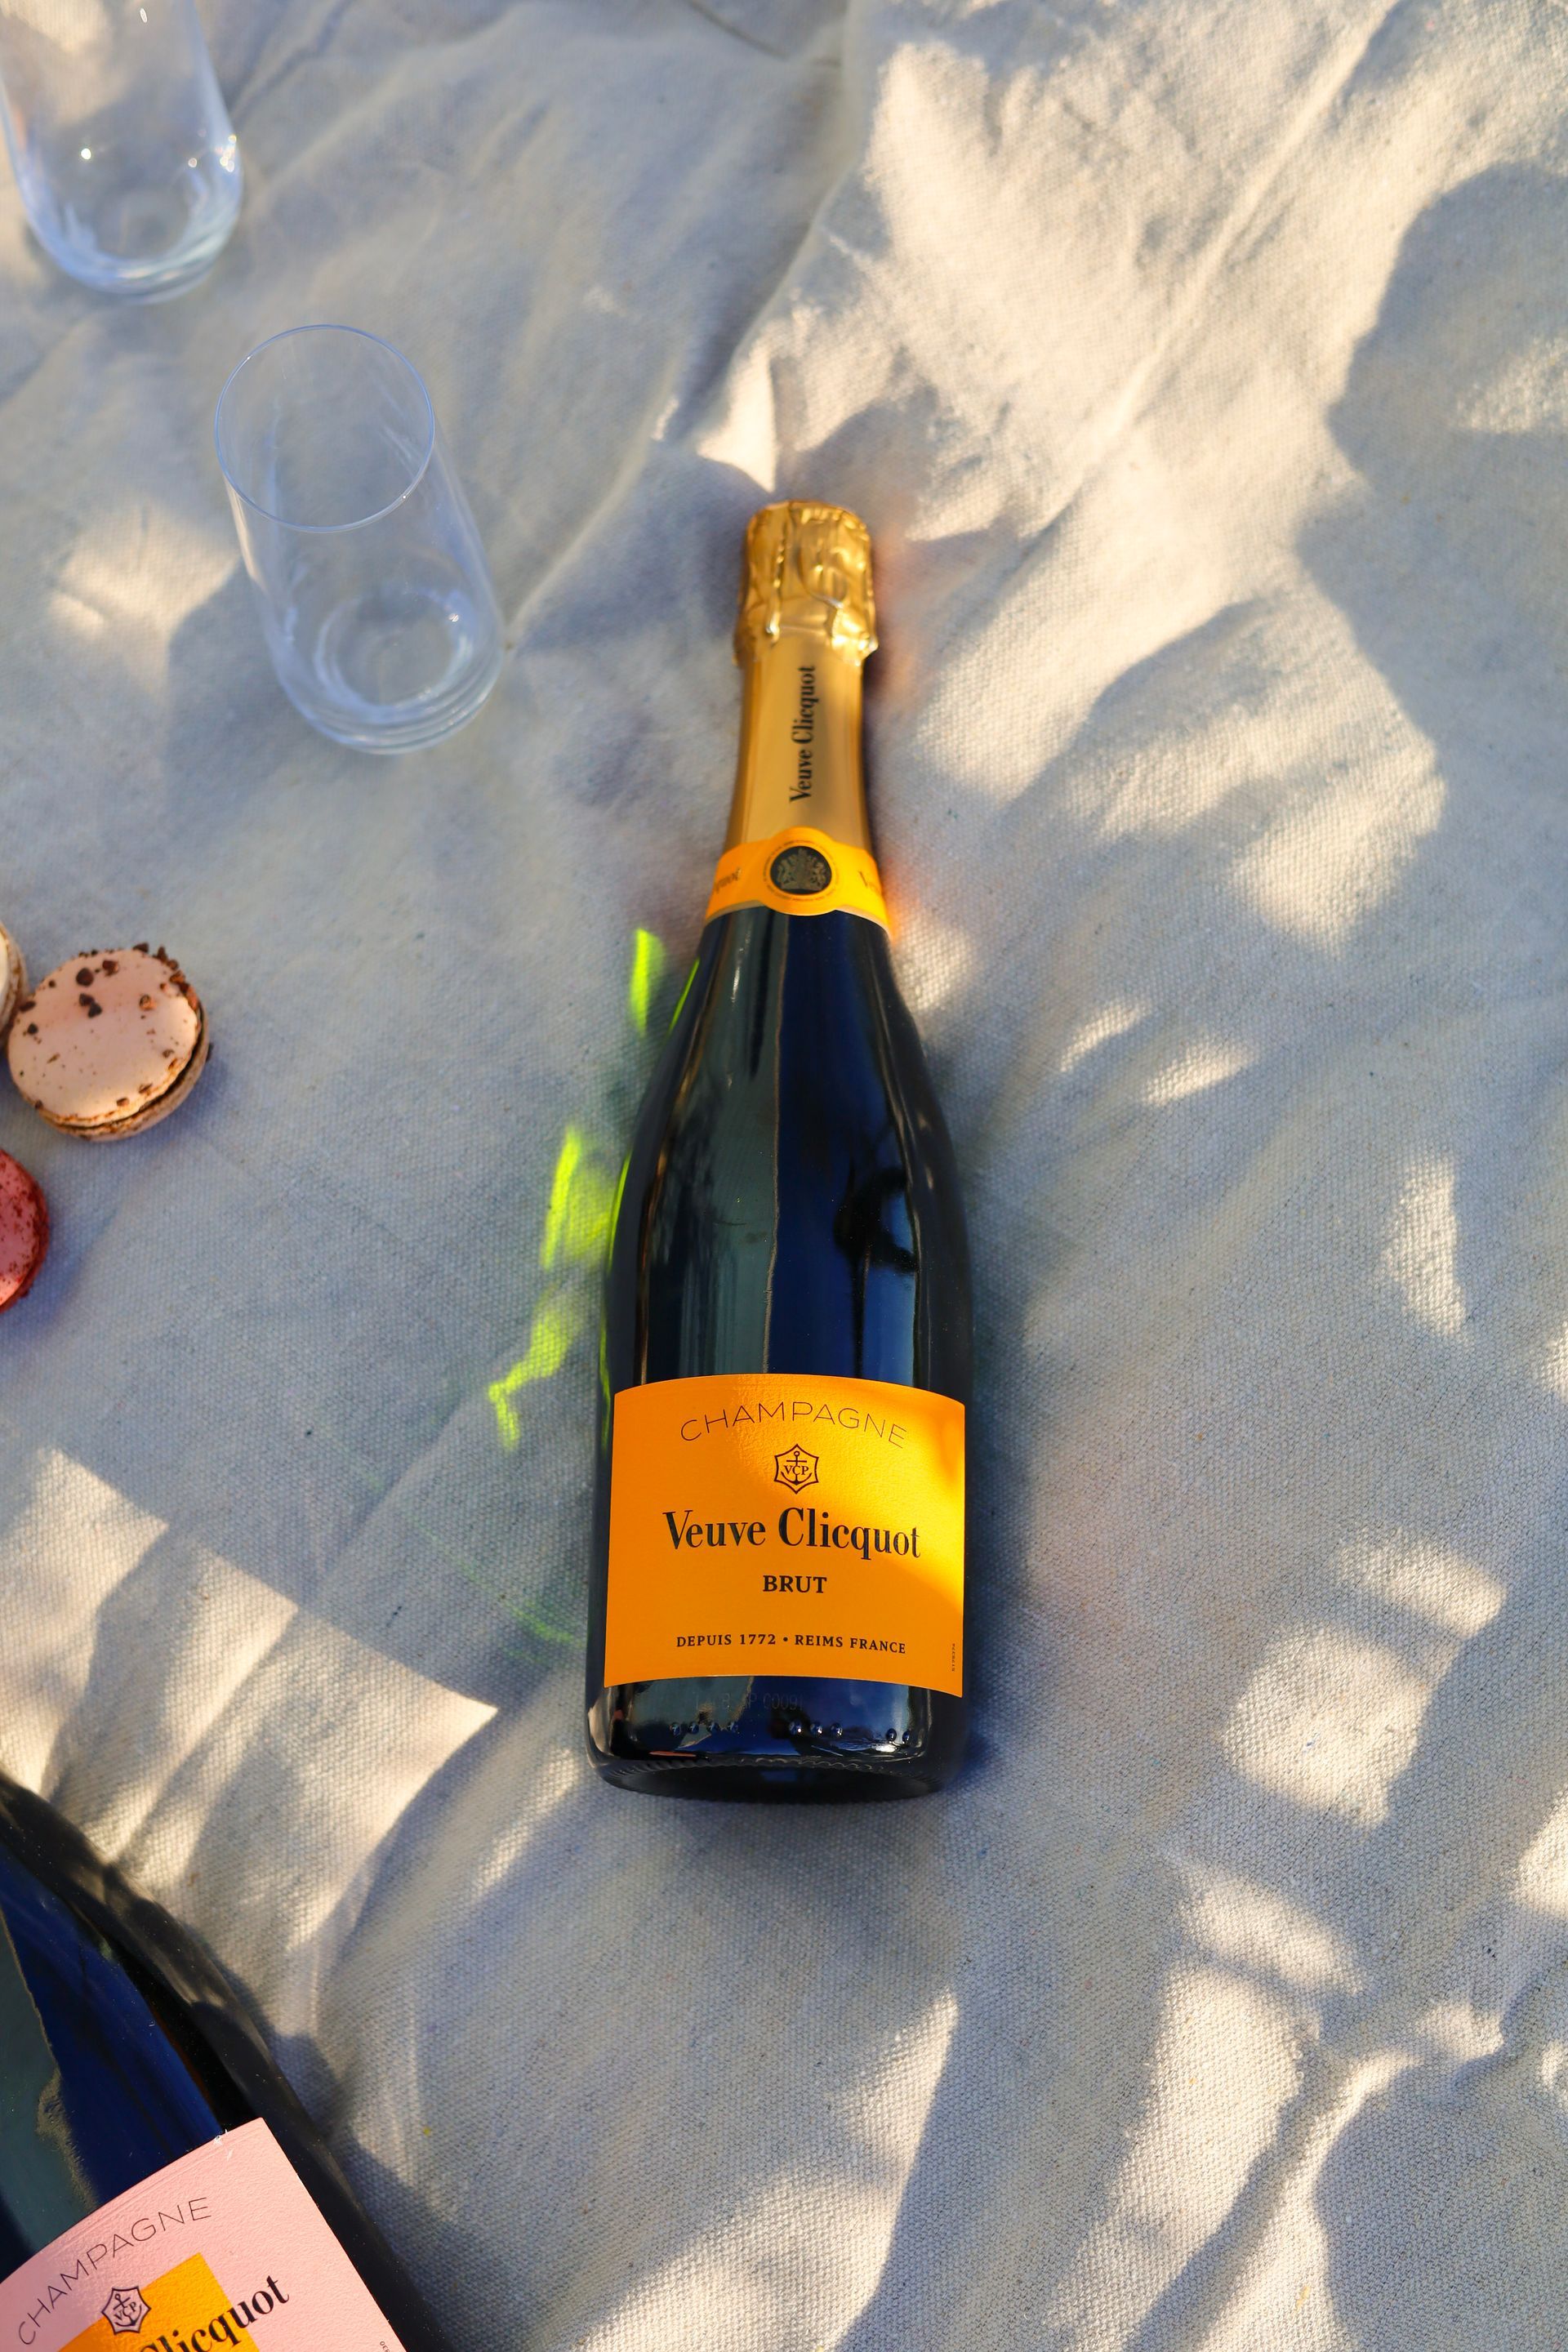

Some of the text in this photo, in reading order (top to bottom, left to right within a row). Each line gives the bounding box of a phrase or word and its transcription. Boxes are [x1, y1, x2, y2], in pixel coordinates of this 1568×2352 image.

[789, 666, 820, 804] Veuve Clicquot
[680, 1401, 907, 1449] CHAMPAGNE
[784, 1464, 809, 1476] VCP
[662, 1507, 921, 1561] Veuve Clicquot
[762, 1575, 827, 1594] BRUT
[676, 1633, 906, 1655] DEPUIS 1772 REIMS FRANCE
[17, 2196, 212, 2346] CHAMPAGNE
[114, 2301, 137, 2321] VCP
